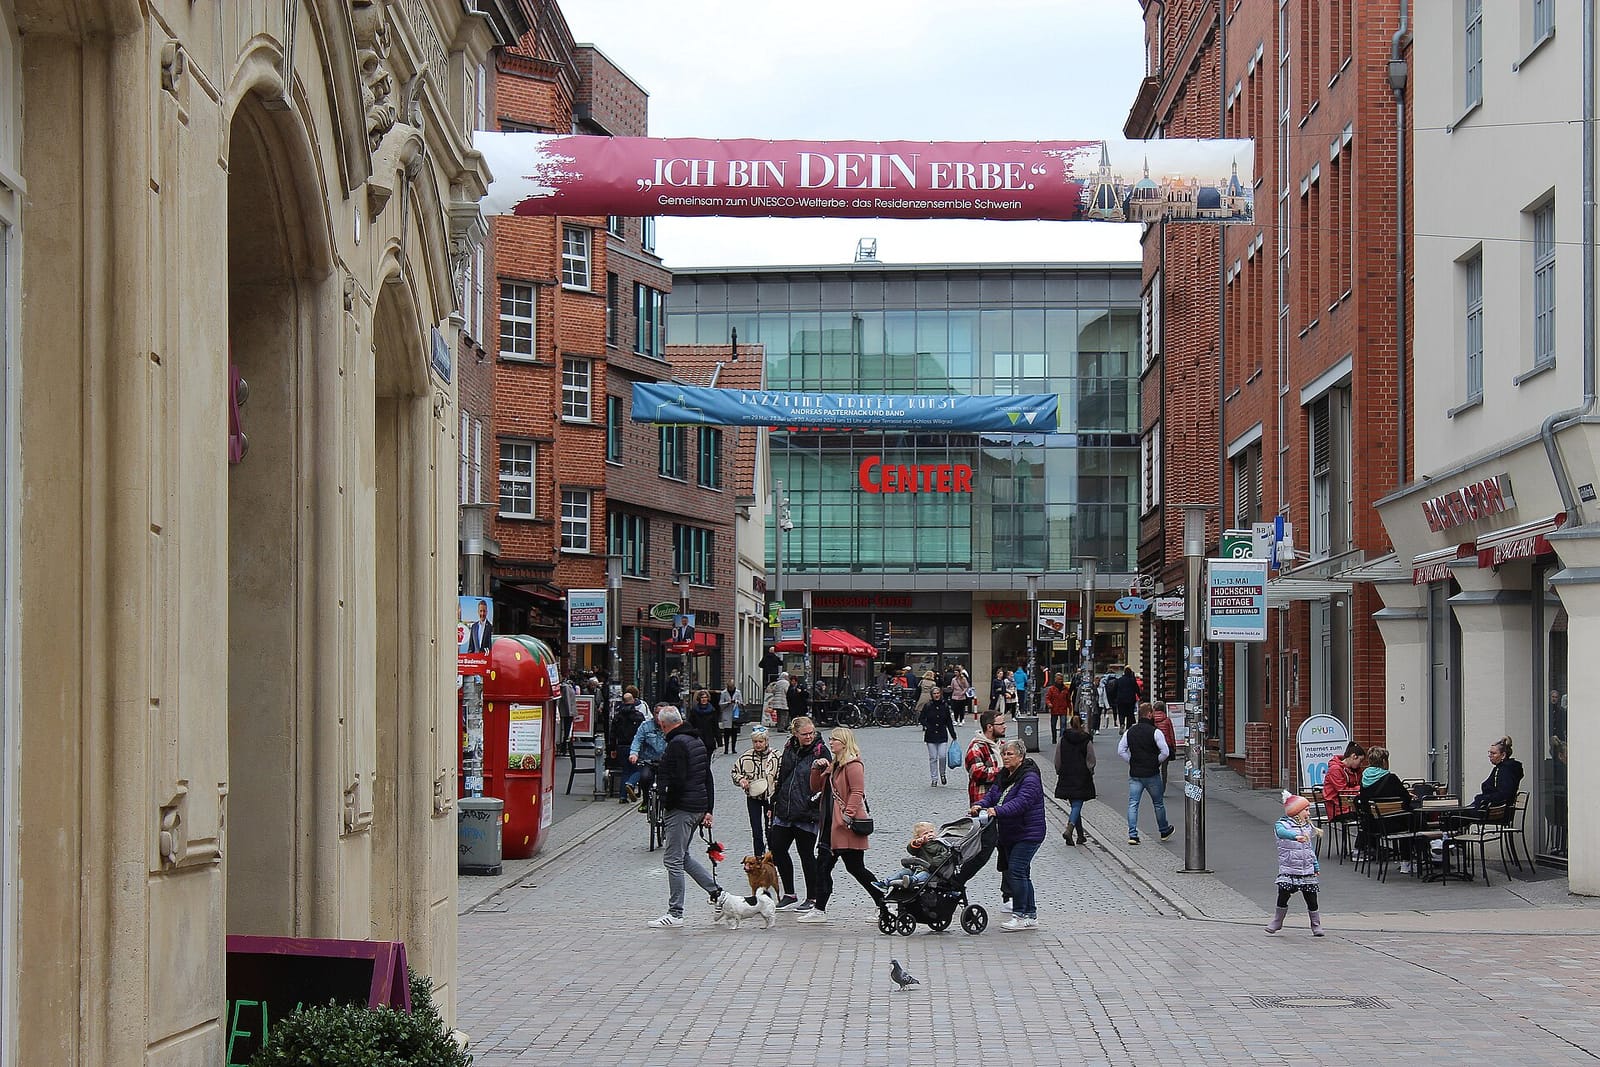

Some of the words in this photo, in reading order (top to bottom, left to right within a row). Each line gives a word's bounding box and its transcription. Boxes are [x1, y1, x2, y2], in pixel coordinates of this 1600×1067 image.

[726, 159, 788, 188] BIN
[796, 152, 921, 189] DEIN
[658, 194, 723, 206] Gemeinsam
[725, 199, 748, 207] zum
[750, 196, 849, 208] UNESCO-Welterbe:
[852, 197, 872, 208] das
[874, 198, 972, 209] Residenzensemble
[974, 199, 1022, 209] Schwerin
[740, 393, 824, 408] JAZZTIME
[838, 396, 895, 409] TRIFFT
[908, 398, 956, 410] KUNST
[1214, 587, 1261, 596] HOCHSCHUL-
[1214, 598, 1250, 606] INFOTAGE
